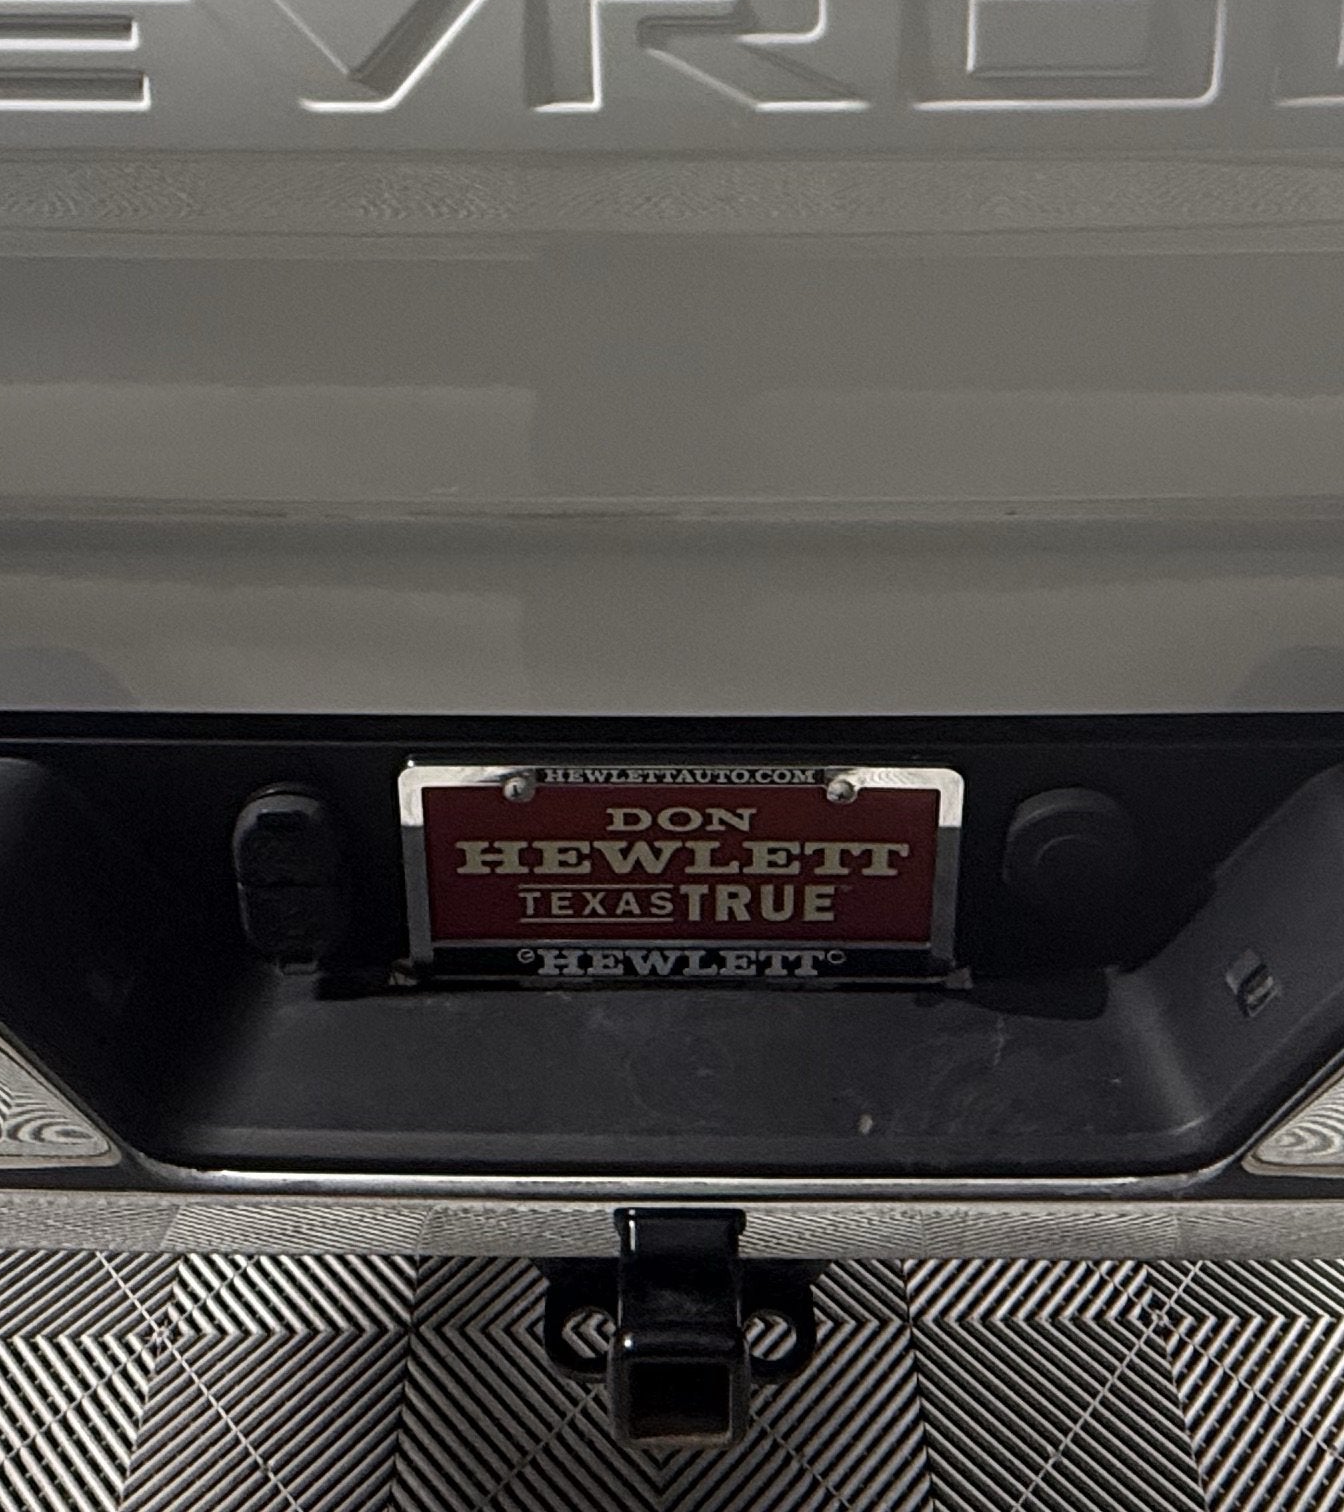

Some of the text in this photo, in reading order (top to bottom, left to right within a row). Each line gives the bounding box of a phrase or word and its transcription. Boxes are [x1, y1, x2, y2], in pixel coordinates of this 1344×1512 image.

[543, 768, 817, 784] HEWLETTAUTO.COM
[605, 807, 757, 832] DON
[455, 840, 910, 876] HEWLETT
[536, 948, 825, 977] HEWLETT
